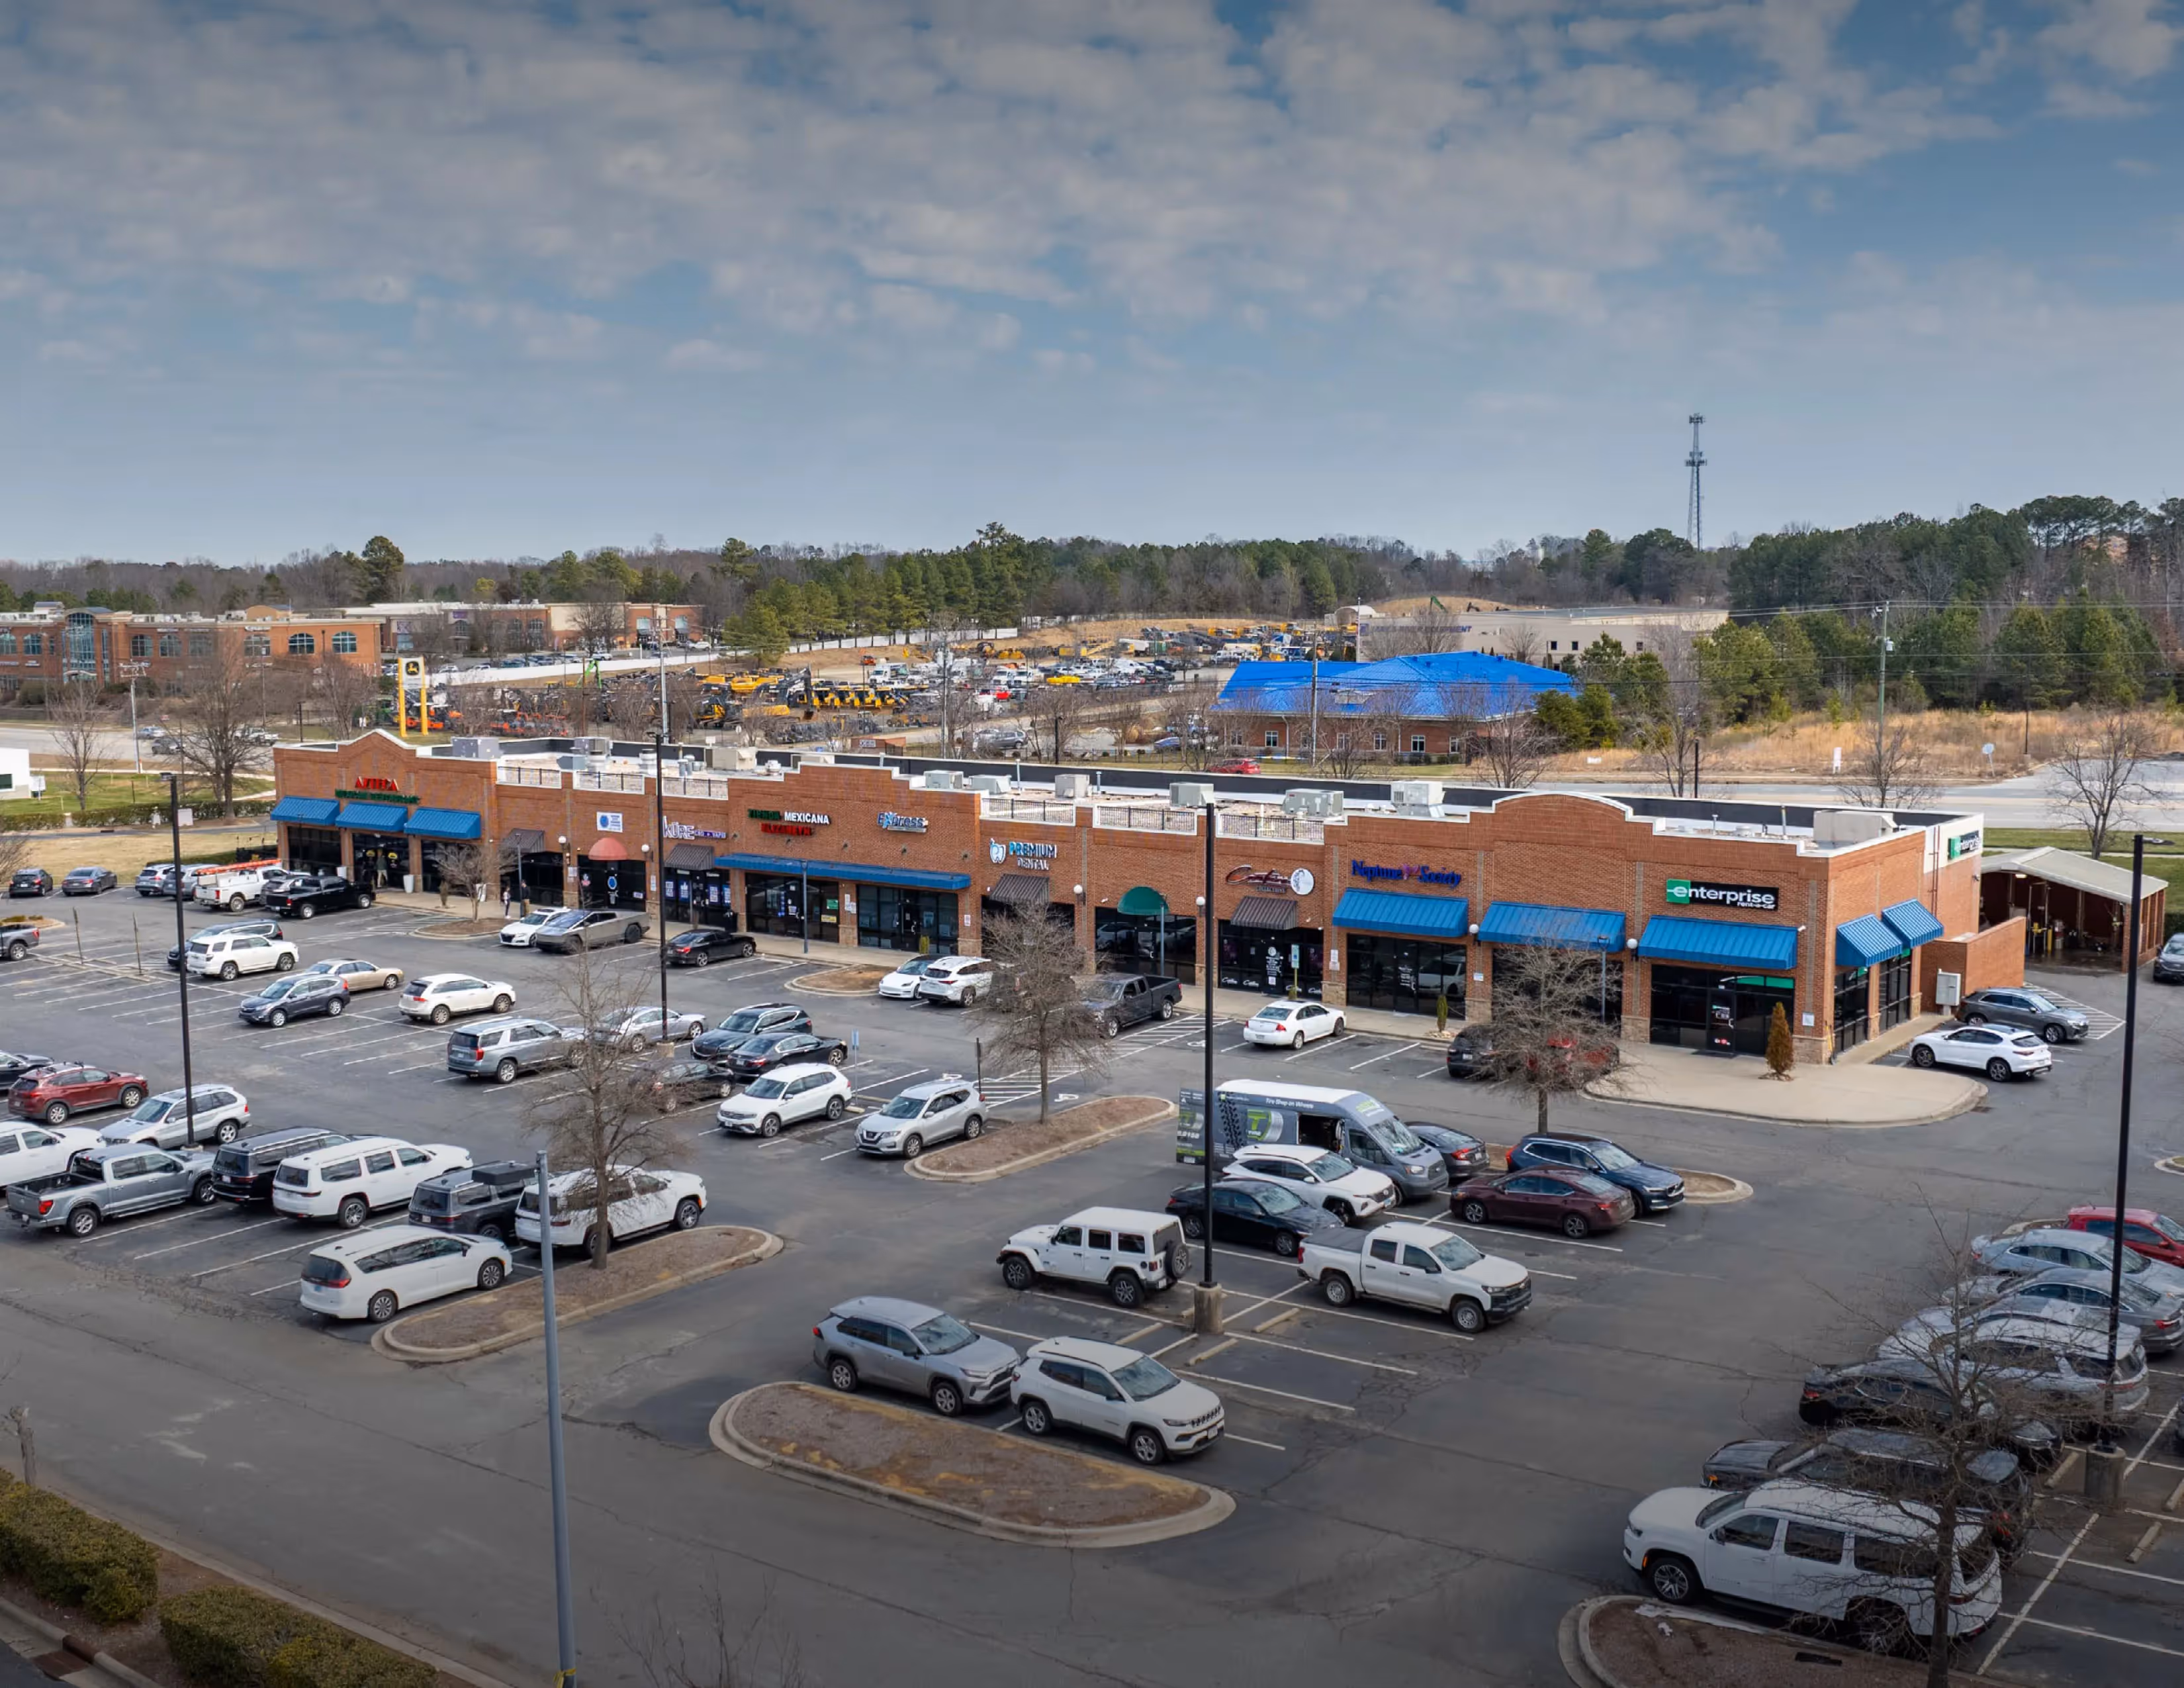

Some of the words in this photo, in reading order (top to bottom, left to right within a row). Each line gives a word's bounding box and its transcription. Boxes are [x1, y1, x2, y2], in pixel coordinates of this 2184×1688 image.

[784, 811, 830, 824] MEXICANA
[1009, 841, 1057, 859] PREMIUM
[1017, 858, 1049, 870] DENTAL
[1351, 860, 1403, 882] Neptune
[1418, 864, 1461, 888] Society
[1668, 886, 1775, 904] enterprise
